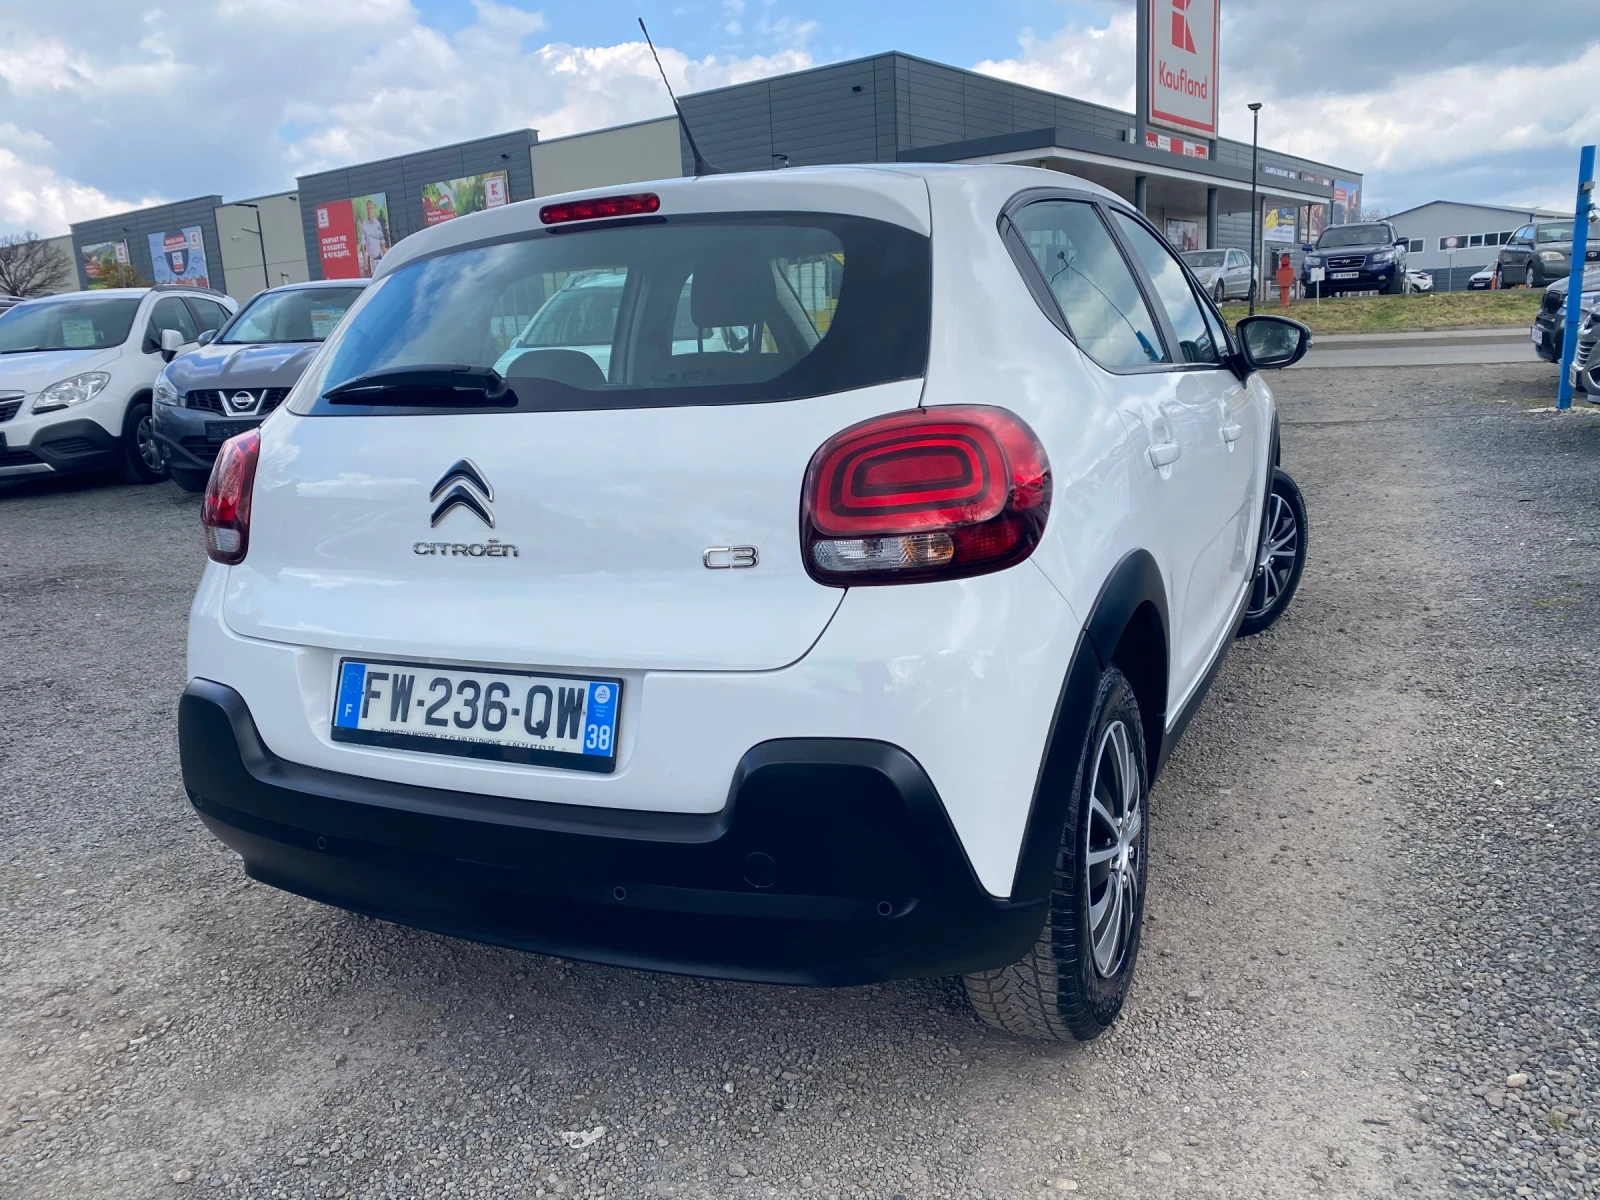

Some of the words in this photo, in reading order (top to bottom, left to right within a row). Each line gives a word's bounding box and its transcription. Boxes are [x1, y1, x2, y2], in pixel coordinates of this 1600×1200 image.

[1159, 60, 1208, 99] Kaufland
[702, 545, 760, 570] C3
[344, 704, 353, 717] F
[361, 672, 585, 740] FW-236-QW
[586, 724, 610, 750] 38
